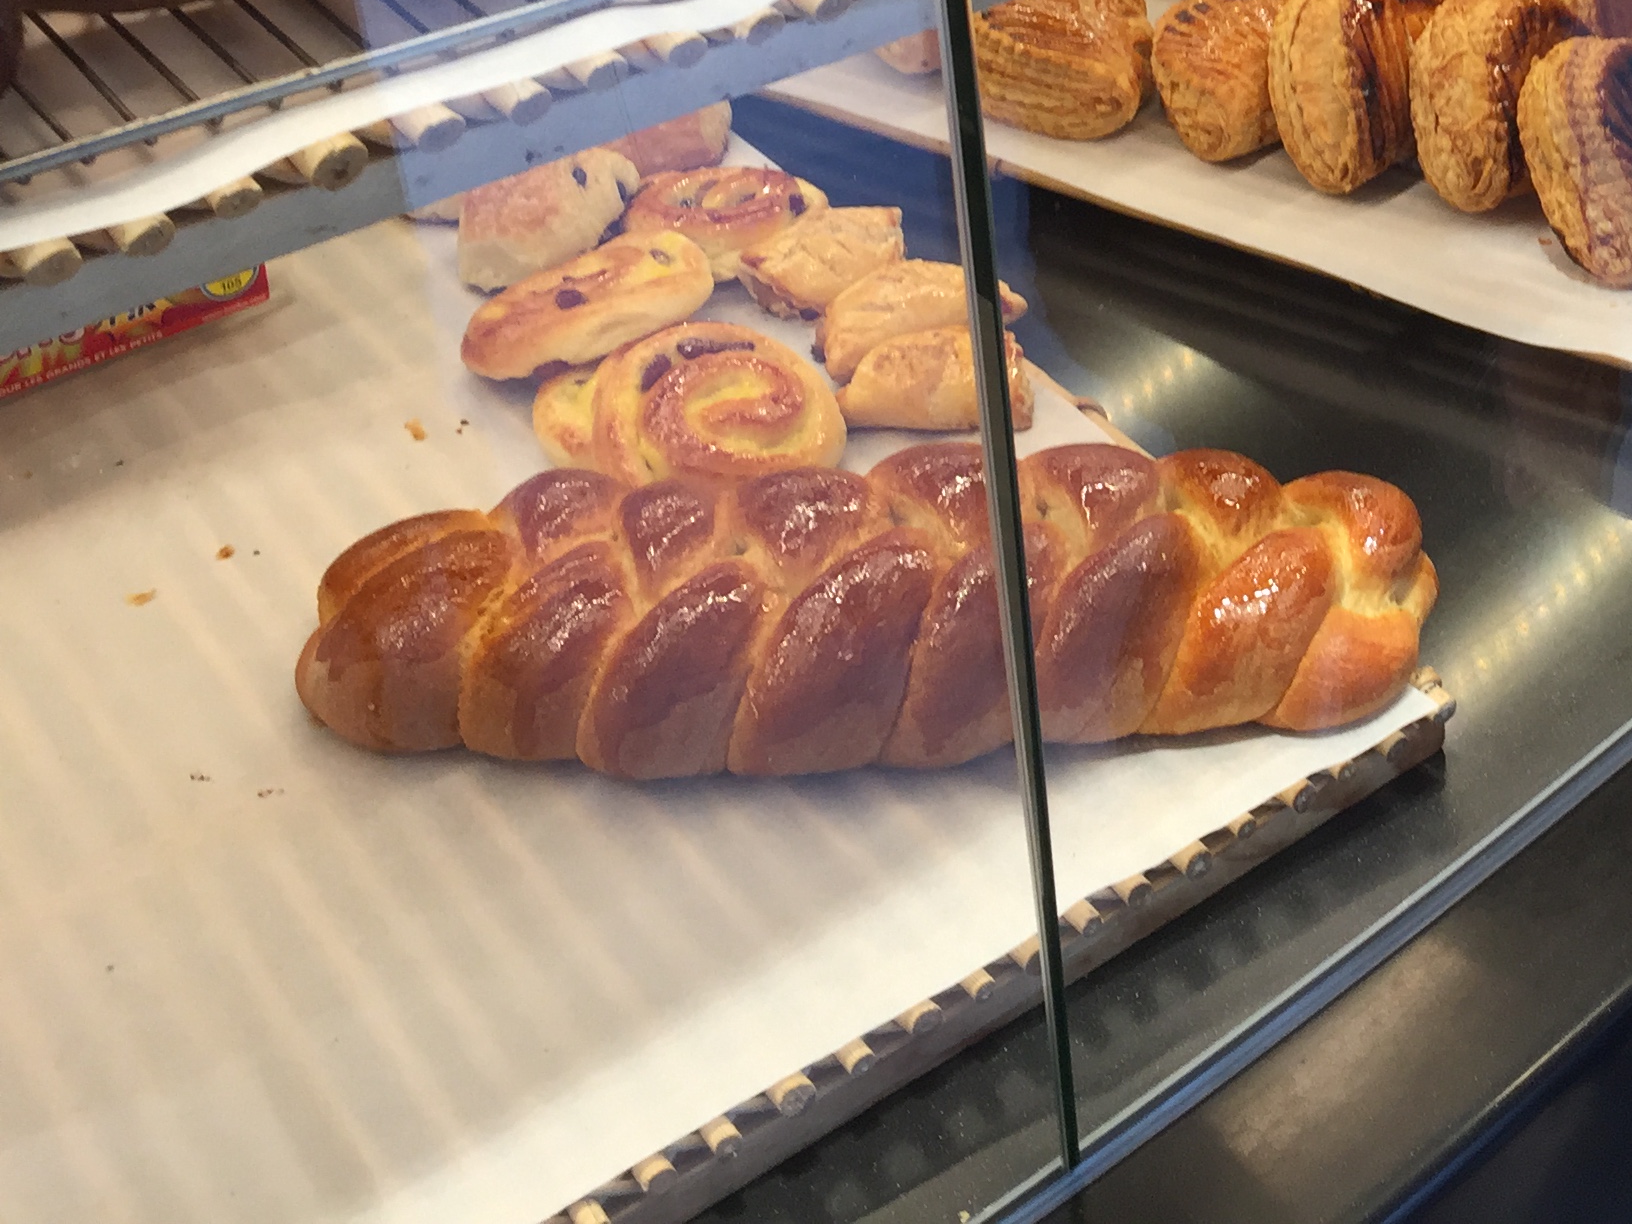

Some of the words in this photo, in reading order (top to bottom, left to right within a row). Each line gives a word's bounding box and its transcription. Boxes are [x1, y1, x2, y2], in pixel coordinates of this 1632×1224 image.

[46, 357, 91, 378] GRANDS
[94, 351, 106, 362] ET
[130, 330, 163, 348] PETITS
